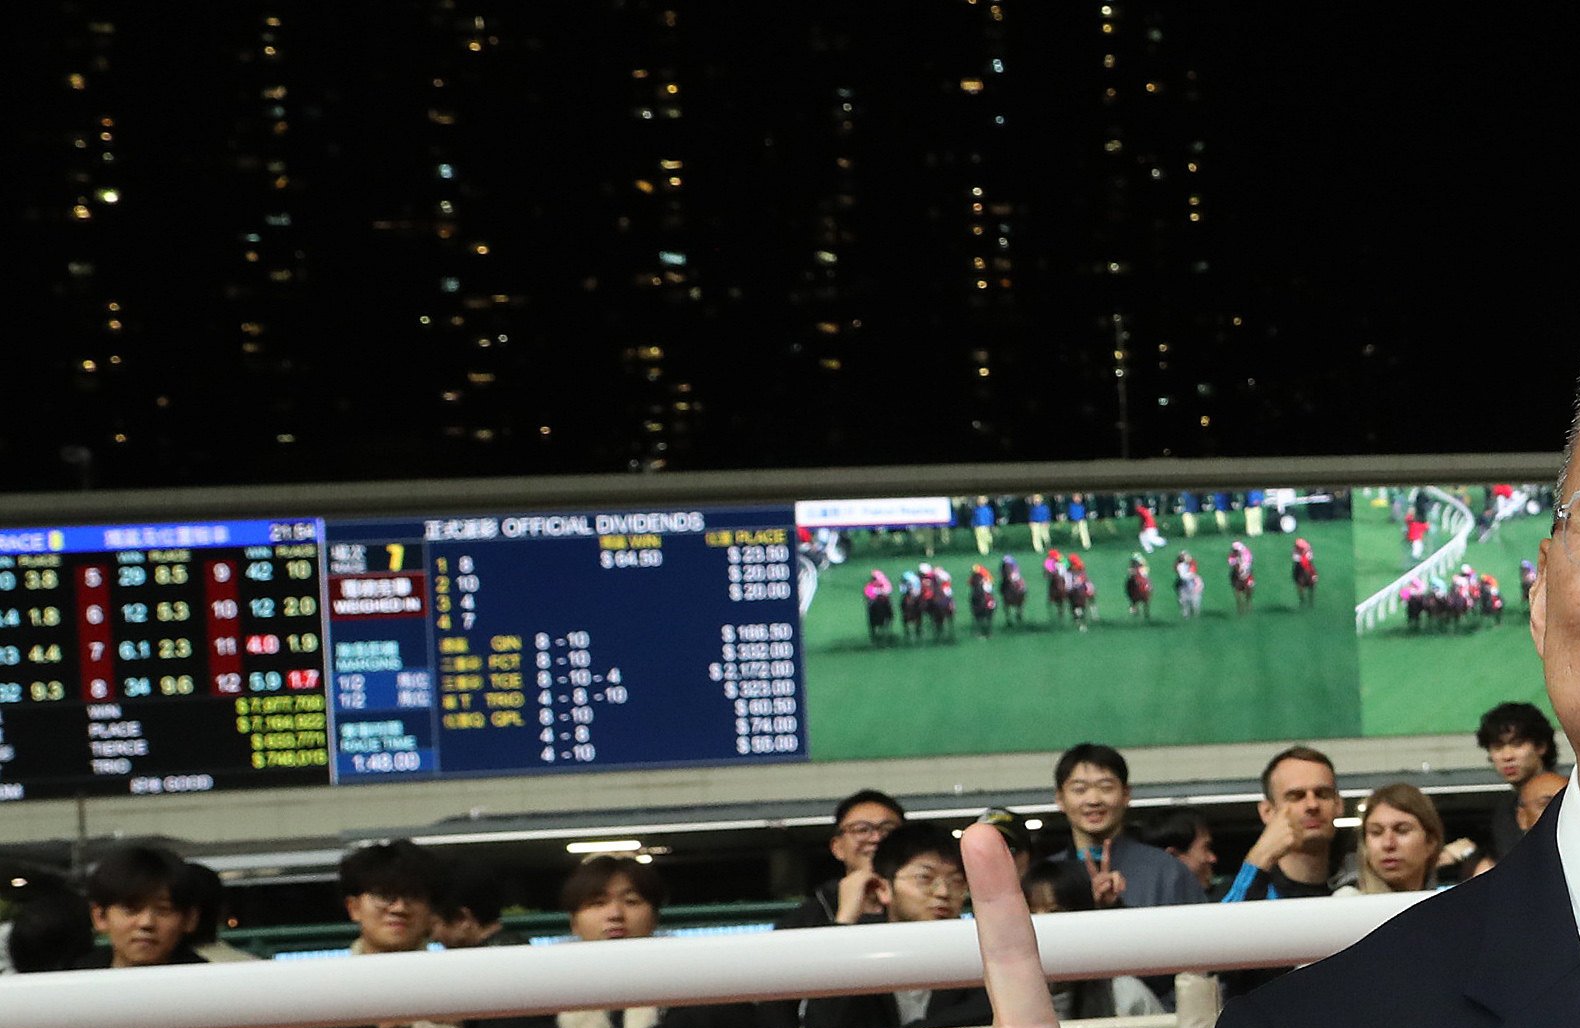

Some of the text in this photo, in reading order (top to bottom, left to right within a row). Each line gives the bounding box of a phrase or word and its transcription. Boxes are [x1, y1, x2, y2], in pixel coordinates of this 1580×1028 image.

[502, 516, 594, 538] OFFICIAL
[596, 512, 705, 534] DIVIDENDS
[629, 534, 661, 548] WIN
[735, 528, 788, 545] PLACE
[385, 543, 404, 572] 7
[435, 555, 474, 574] 1 8
[84, 567, 103, 588] 5
[213, 563, 231, 582] 9
[245, 561, 273, 581] 42
[286, 559, 312, 579] 10
[435, 575, 450, 593] 2
[456, 574, 480, 593] 10
[121, 602, 148, 623] 12
[211, 599, 238, 619] 10
[249, 597, 275, 617] 12
[436, 593, 475, 612] 3 4
[86, 604, 104, 625] 6
[436, 612, 476, 630] 4 7
[158, 638, 192, 659] 2.3
[214, 637, 236, 656] 11
[535, 631, 550, 650] 8
[567, 630, 590, 649] 10
[28, 643, 62, 663] 4.4
[88, 641, 105, 662] 7
[119, 640, 151, 661] 6.1
[536, 651, 551, 669] 8
[567, 649, 591, 668] 10
[124, 677, 151, 697] 34
[215, 672, 241, 692] 12
[537, 670, 552, 688] 8
[568, 668, 592, 687] 10
[606, 667, 621, 684] 4
[30, 681, 65, 701] 9.3
[90, 678, 107, 699] 8
[538, 689, 552, 706] 4
[573, 687, 588, 706] 8
[604, 685, 628, 704] 10
[484, 690, 525, 709] TRIO
[539, 707, 554, 726] 8
[570, 705, 594, 725] 10
[88, 720, 142, 738] PLACE
[539, 726, 554, 744] 4
[574, 724, 590, 743] 8
[89, 738, 149, 757] TIERCE
[383, 735, 417, 750] TIME
[540, 745, 555, 763] 4
[572, 743, 595, 762] 10
[91, 757, 132, 775] TRIO
